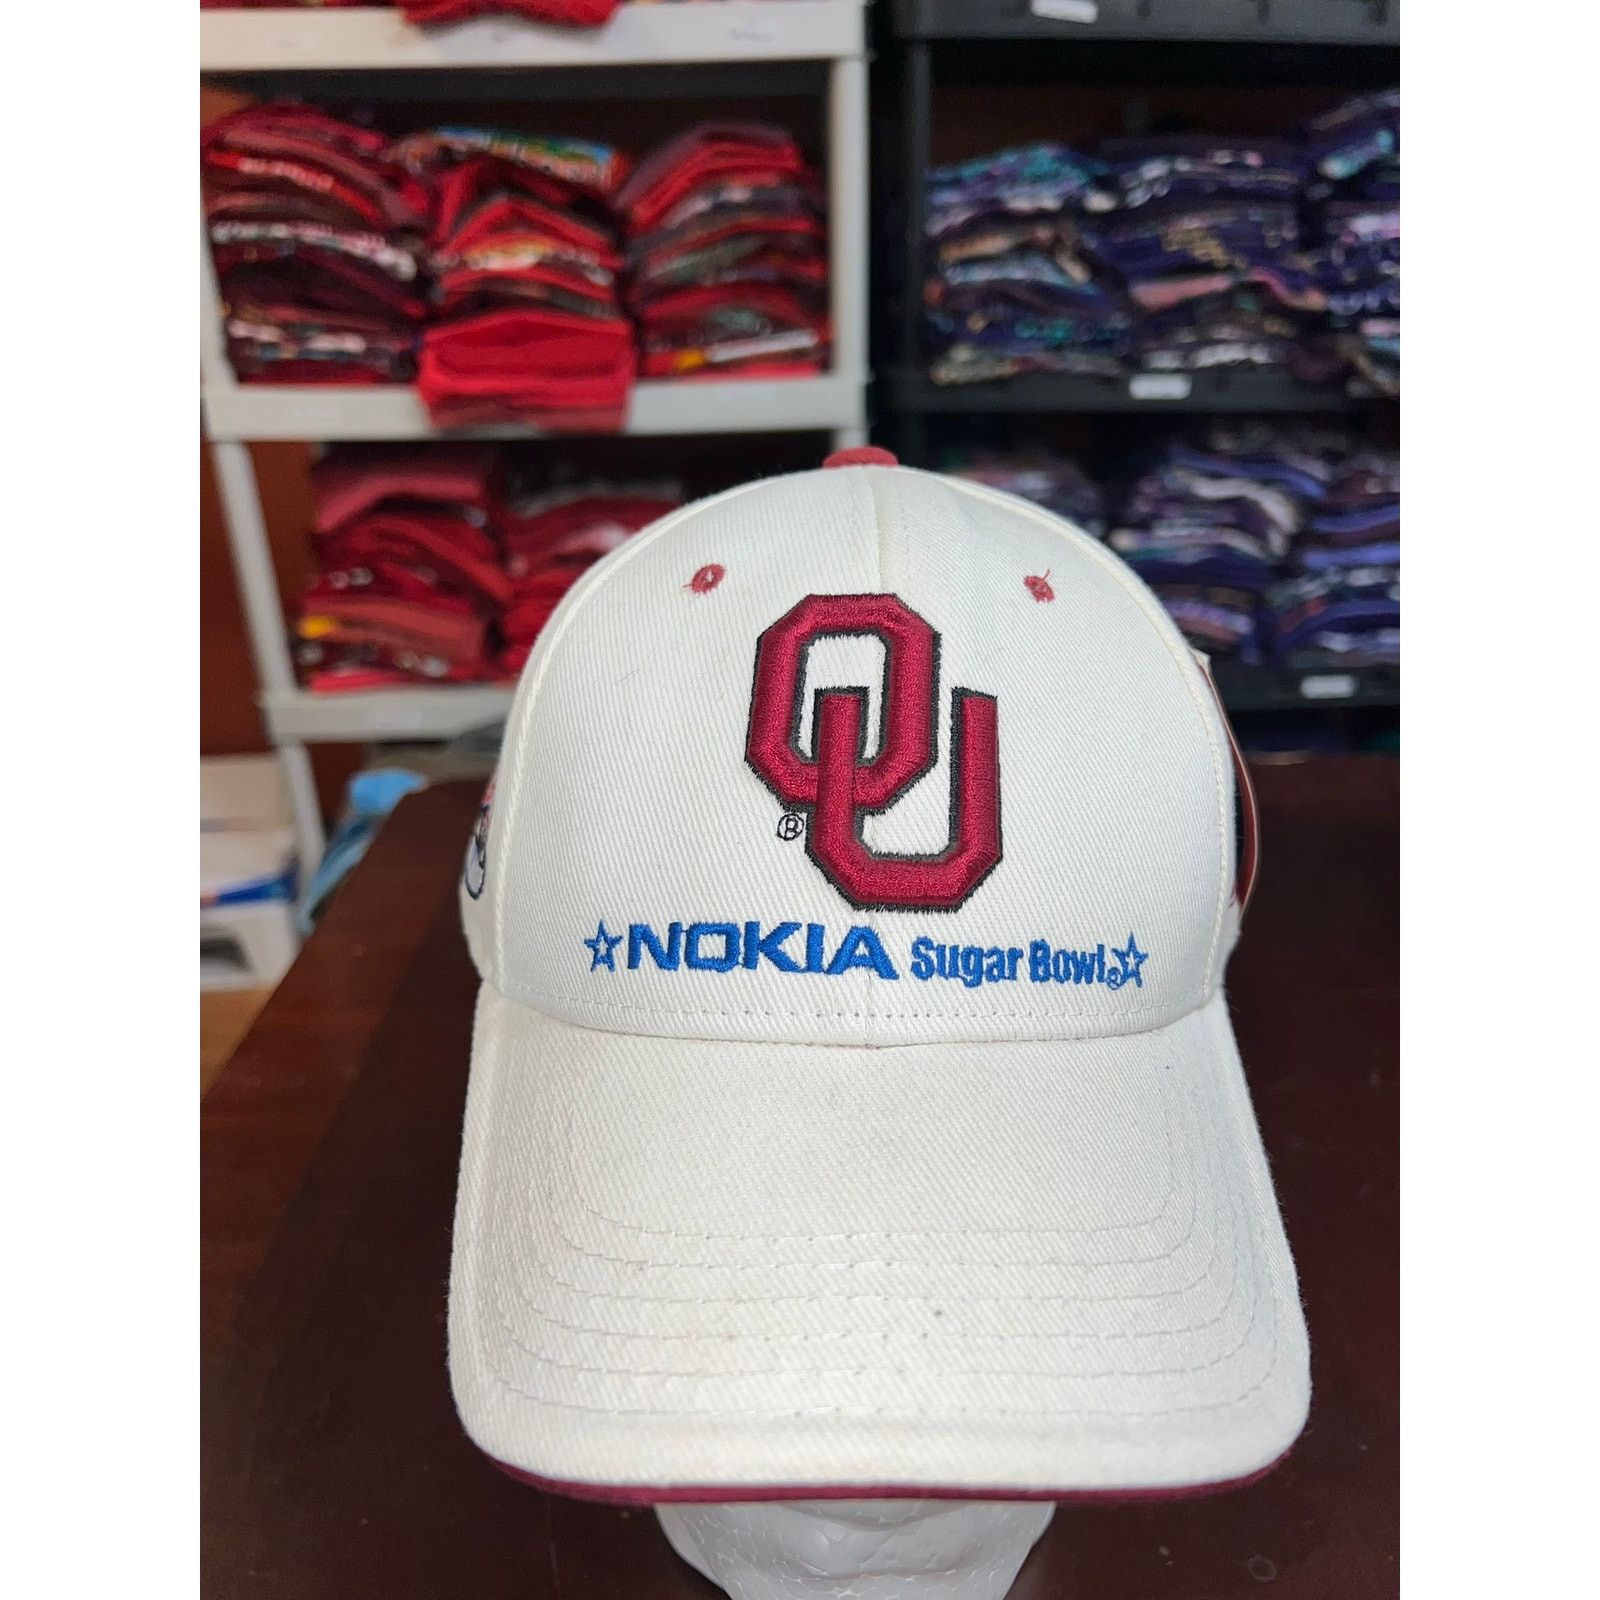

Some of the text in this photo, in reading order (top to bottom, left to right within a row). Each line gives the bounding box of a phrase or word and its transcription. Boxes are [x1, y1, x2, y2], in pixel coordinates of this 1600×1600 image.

[744, 593, 1003, 913] OU
[627, 921, 899, 980] NOKIA
[911, 936, 1024, 988] Sugar
